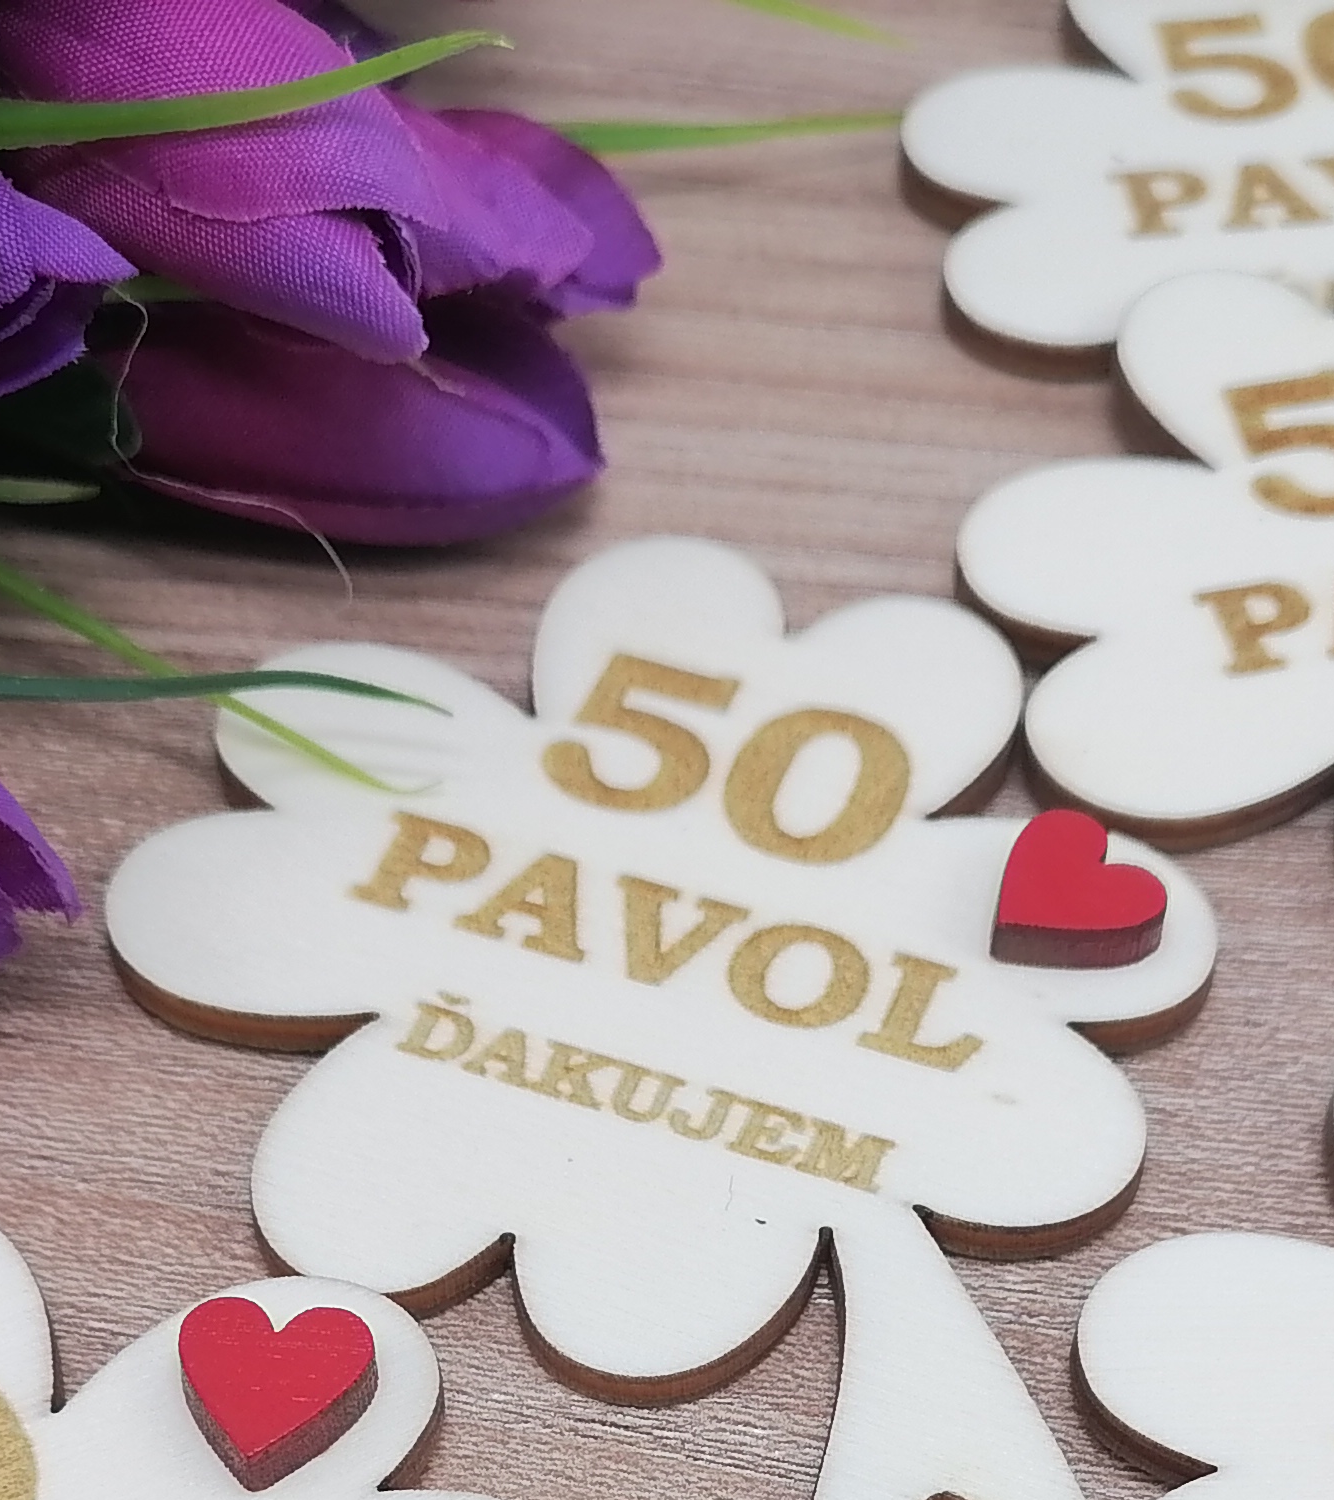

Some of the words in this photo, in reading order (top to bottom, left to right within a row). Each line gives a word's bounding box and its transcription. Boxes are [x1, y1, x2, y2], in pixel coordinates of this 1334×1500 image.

[540, 653, 913, 865] 50
[351, 811, 983, 1070] PAVOL
[397, 990, 895, 1192] ĎAKUJEM
